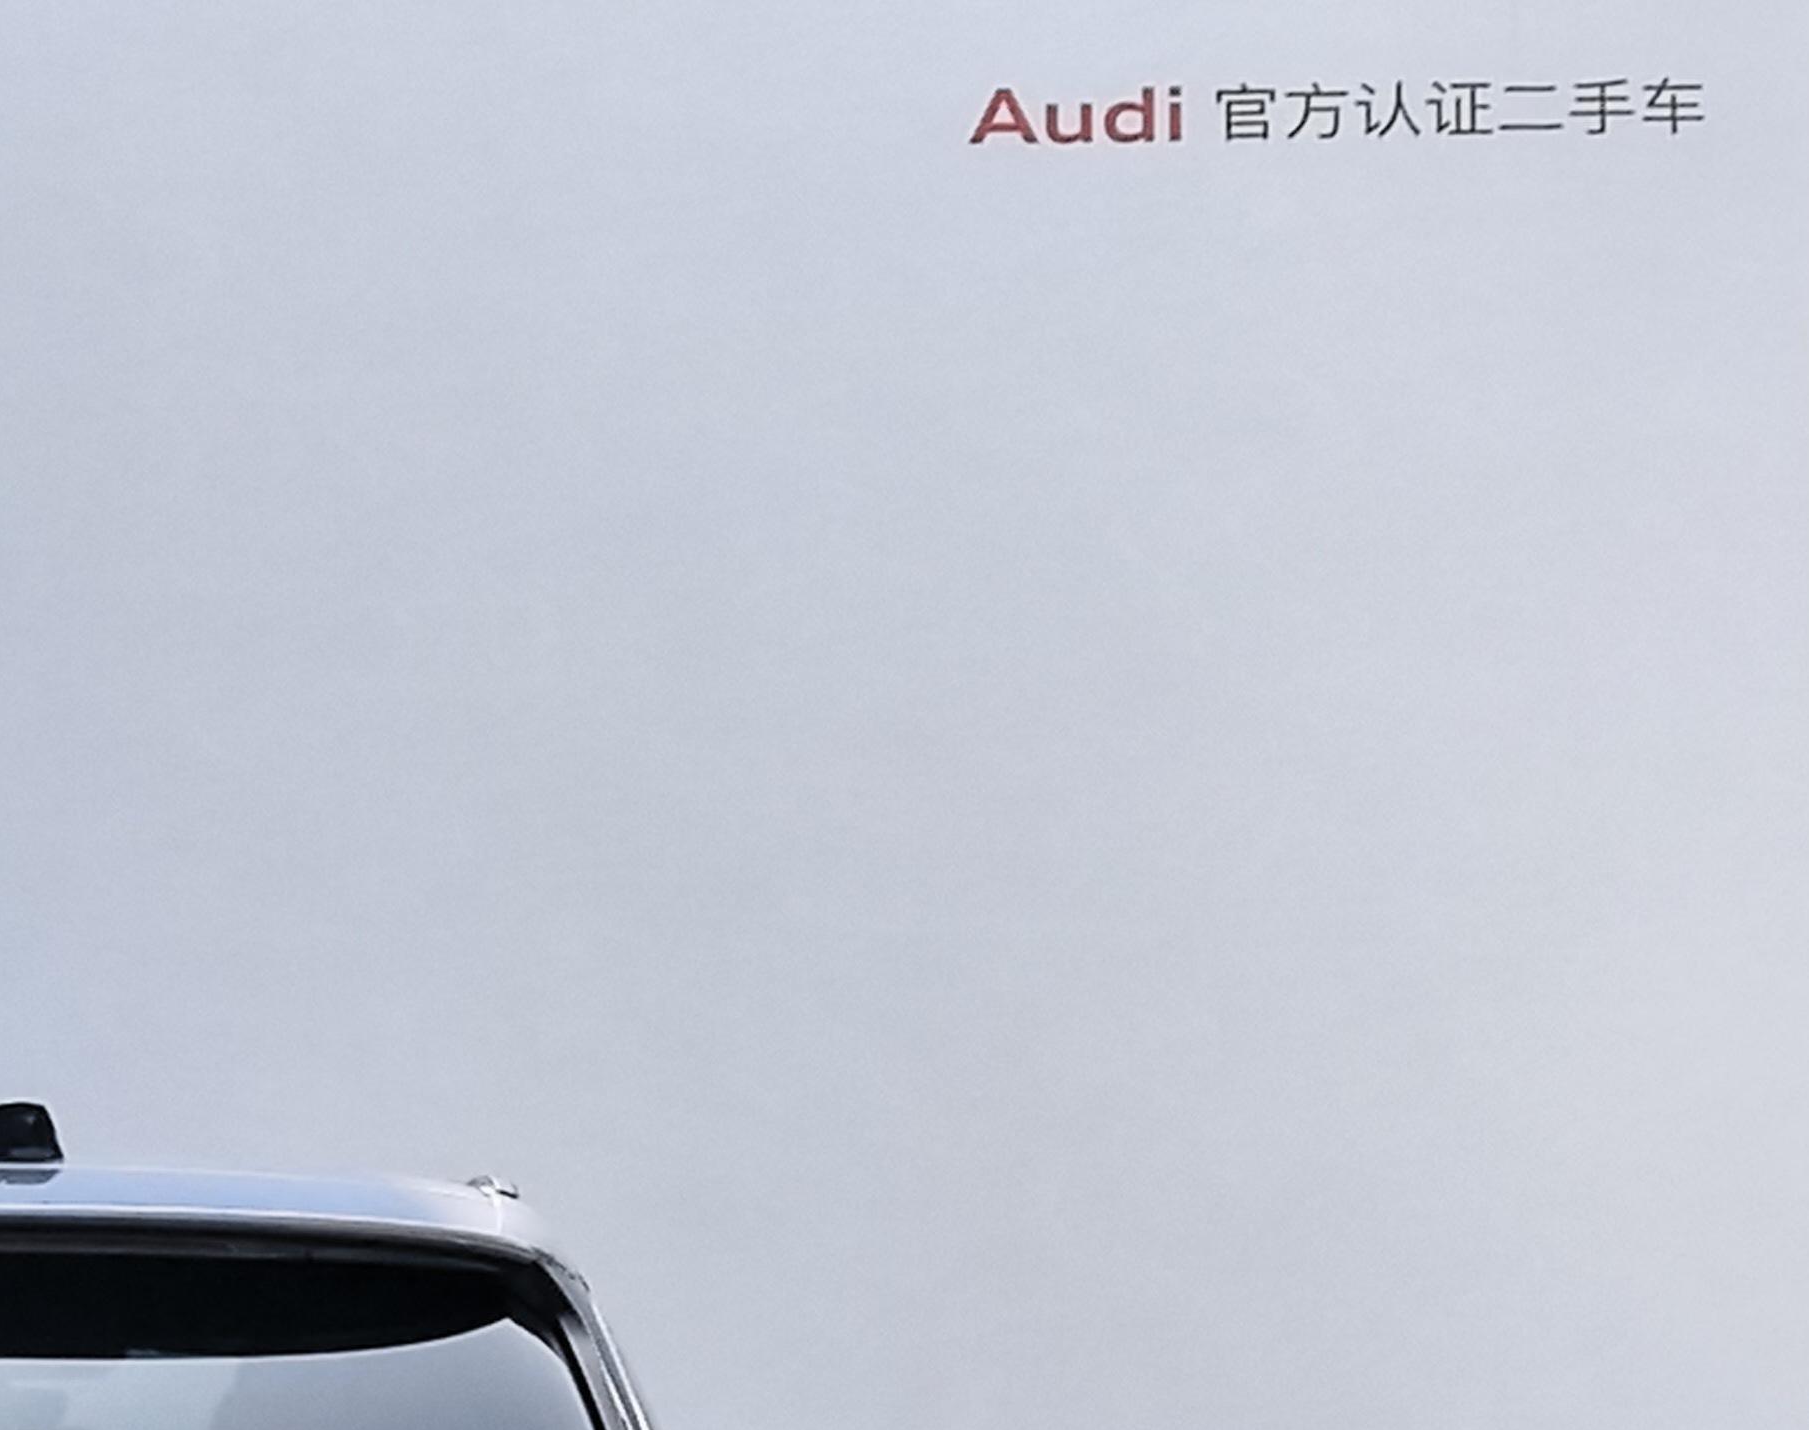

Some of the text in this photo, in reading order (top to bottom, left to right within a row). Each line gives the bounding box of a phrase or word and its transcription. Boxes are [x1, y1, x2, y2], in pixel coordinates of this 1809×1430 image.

[968, 76, 1707, 146] Audi 官方认证二手车
